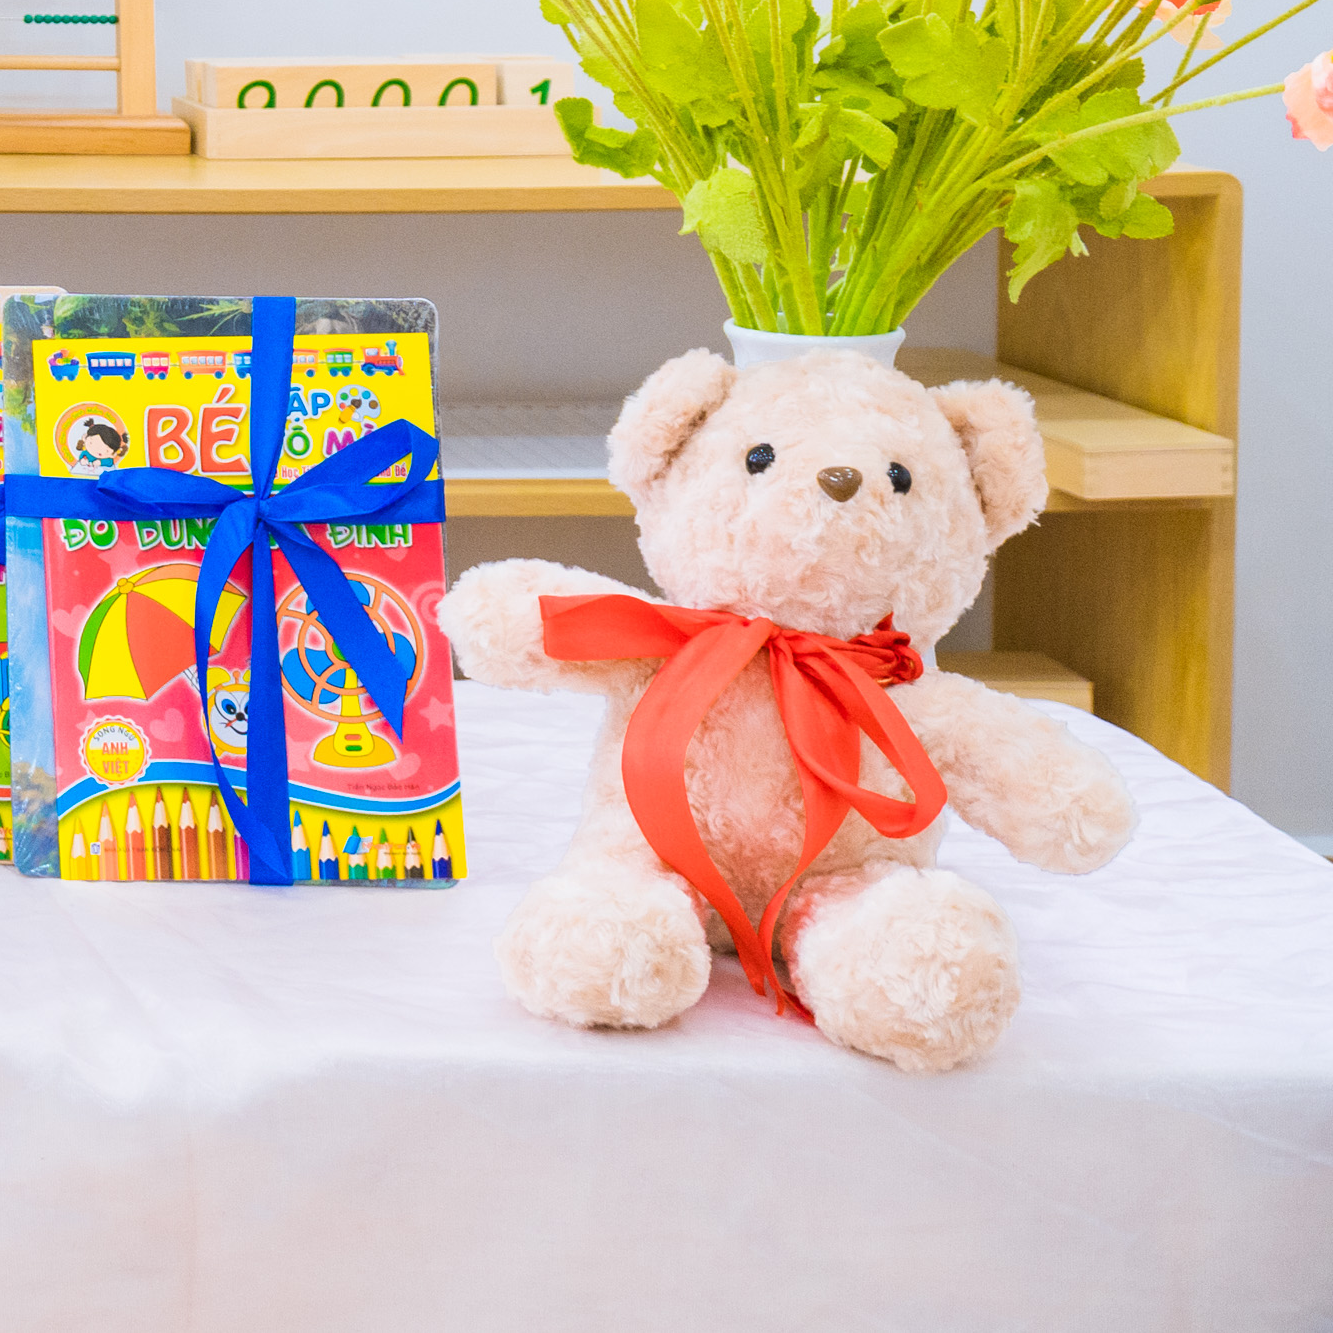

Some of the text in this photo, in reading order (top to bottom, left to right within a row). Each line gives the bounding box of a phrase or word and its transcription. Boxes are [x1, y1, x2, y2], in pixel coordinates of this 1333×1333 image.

[287, 386, 331, 422] ẬP
[147, 386, 250, 474] BÉ
[93, 726, 115, 741] SONG
[101, 742, 129, 755] ANH
[102, 758, 129, 777] VIỆT
